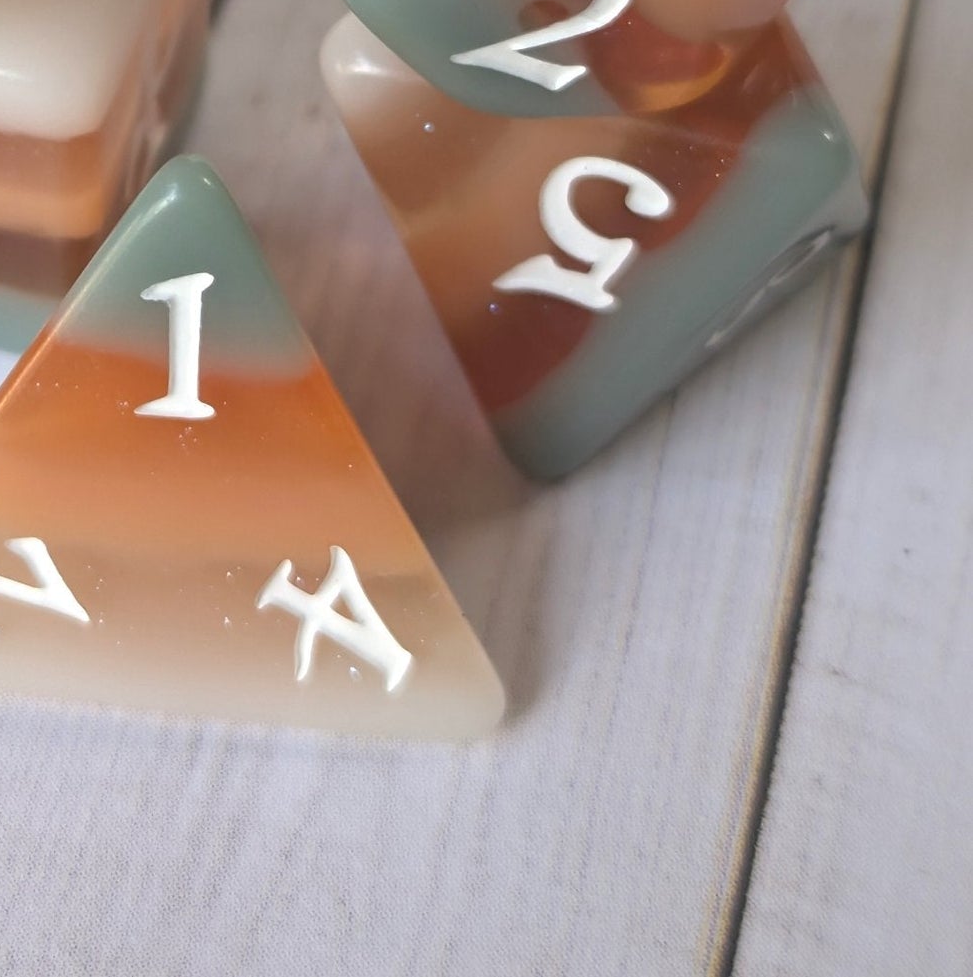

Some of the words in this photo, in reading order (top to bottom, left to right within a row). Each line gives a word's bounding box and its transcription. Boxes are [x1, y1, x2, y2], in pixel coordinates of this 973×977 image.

[492, 157, 671, 310] 5
[134, 272, 215, 418] 1
[257, 546, 412, 691] 4
